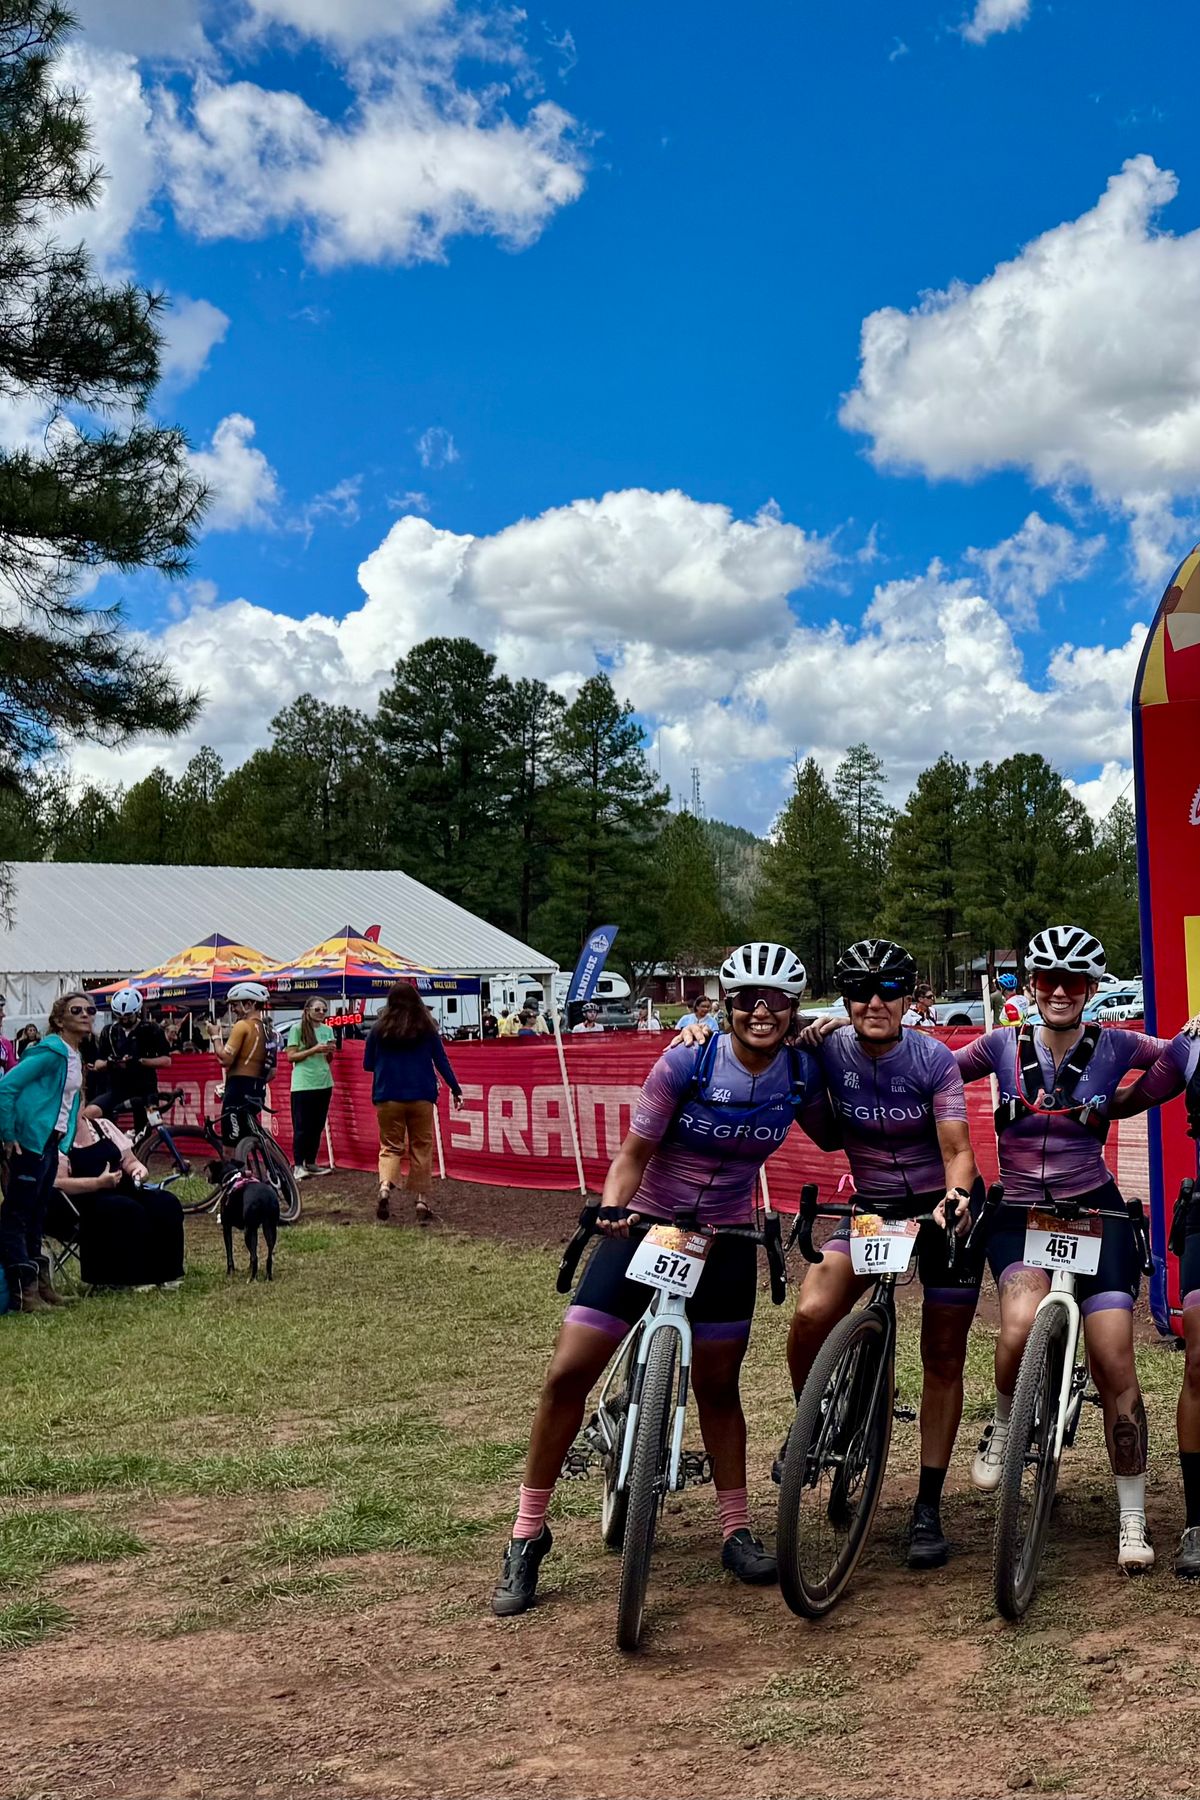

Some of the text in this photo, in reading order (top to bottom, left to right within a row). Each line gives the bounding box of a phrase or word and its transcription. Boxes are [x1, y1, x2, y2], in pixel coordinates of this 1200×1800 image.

[449, 1084, 644, 1160] SRAM
[864, 1242, 890, 1262] 211
[1045, 1238, 1078, 1260] 451
[654, 1254, 692, 1282] 514
